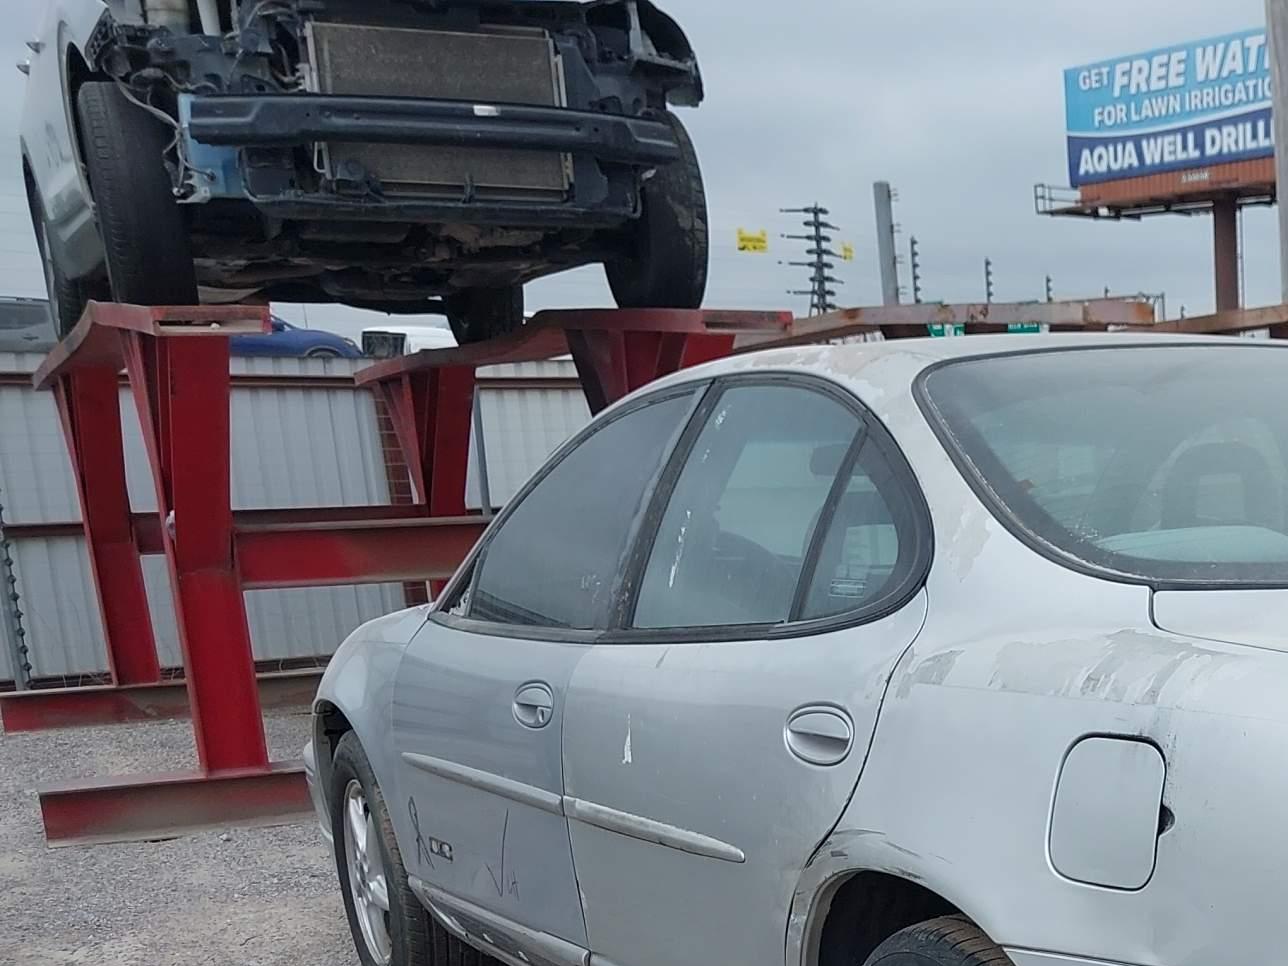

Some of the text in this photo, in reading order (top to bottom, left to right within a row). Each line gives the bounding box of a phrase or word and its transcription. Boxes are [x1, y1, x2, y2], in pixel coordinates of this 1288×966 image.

[1078, 67, 1111, 91] GET
[1112, 50, 1188, 98] FREE
[1094, 76, 1272, 128] FOR LAWN IRRIGATIO
[1079, 141, 1139, 176] AQUA
[1141, 131, 1201, 166] WELL
